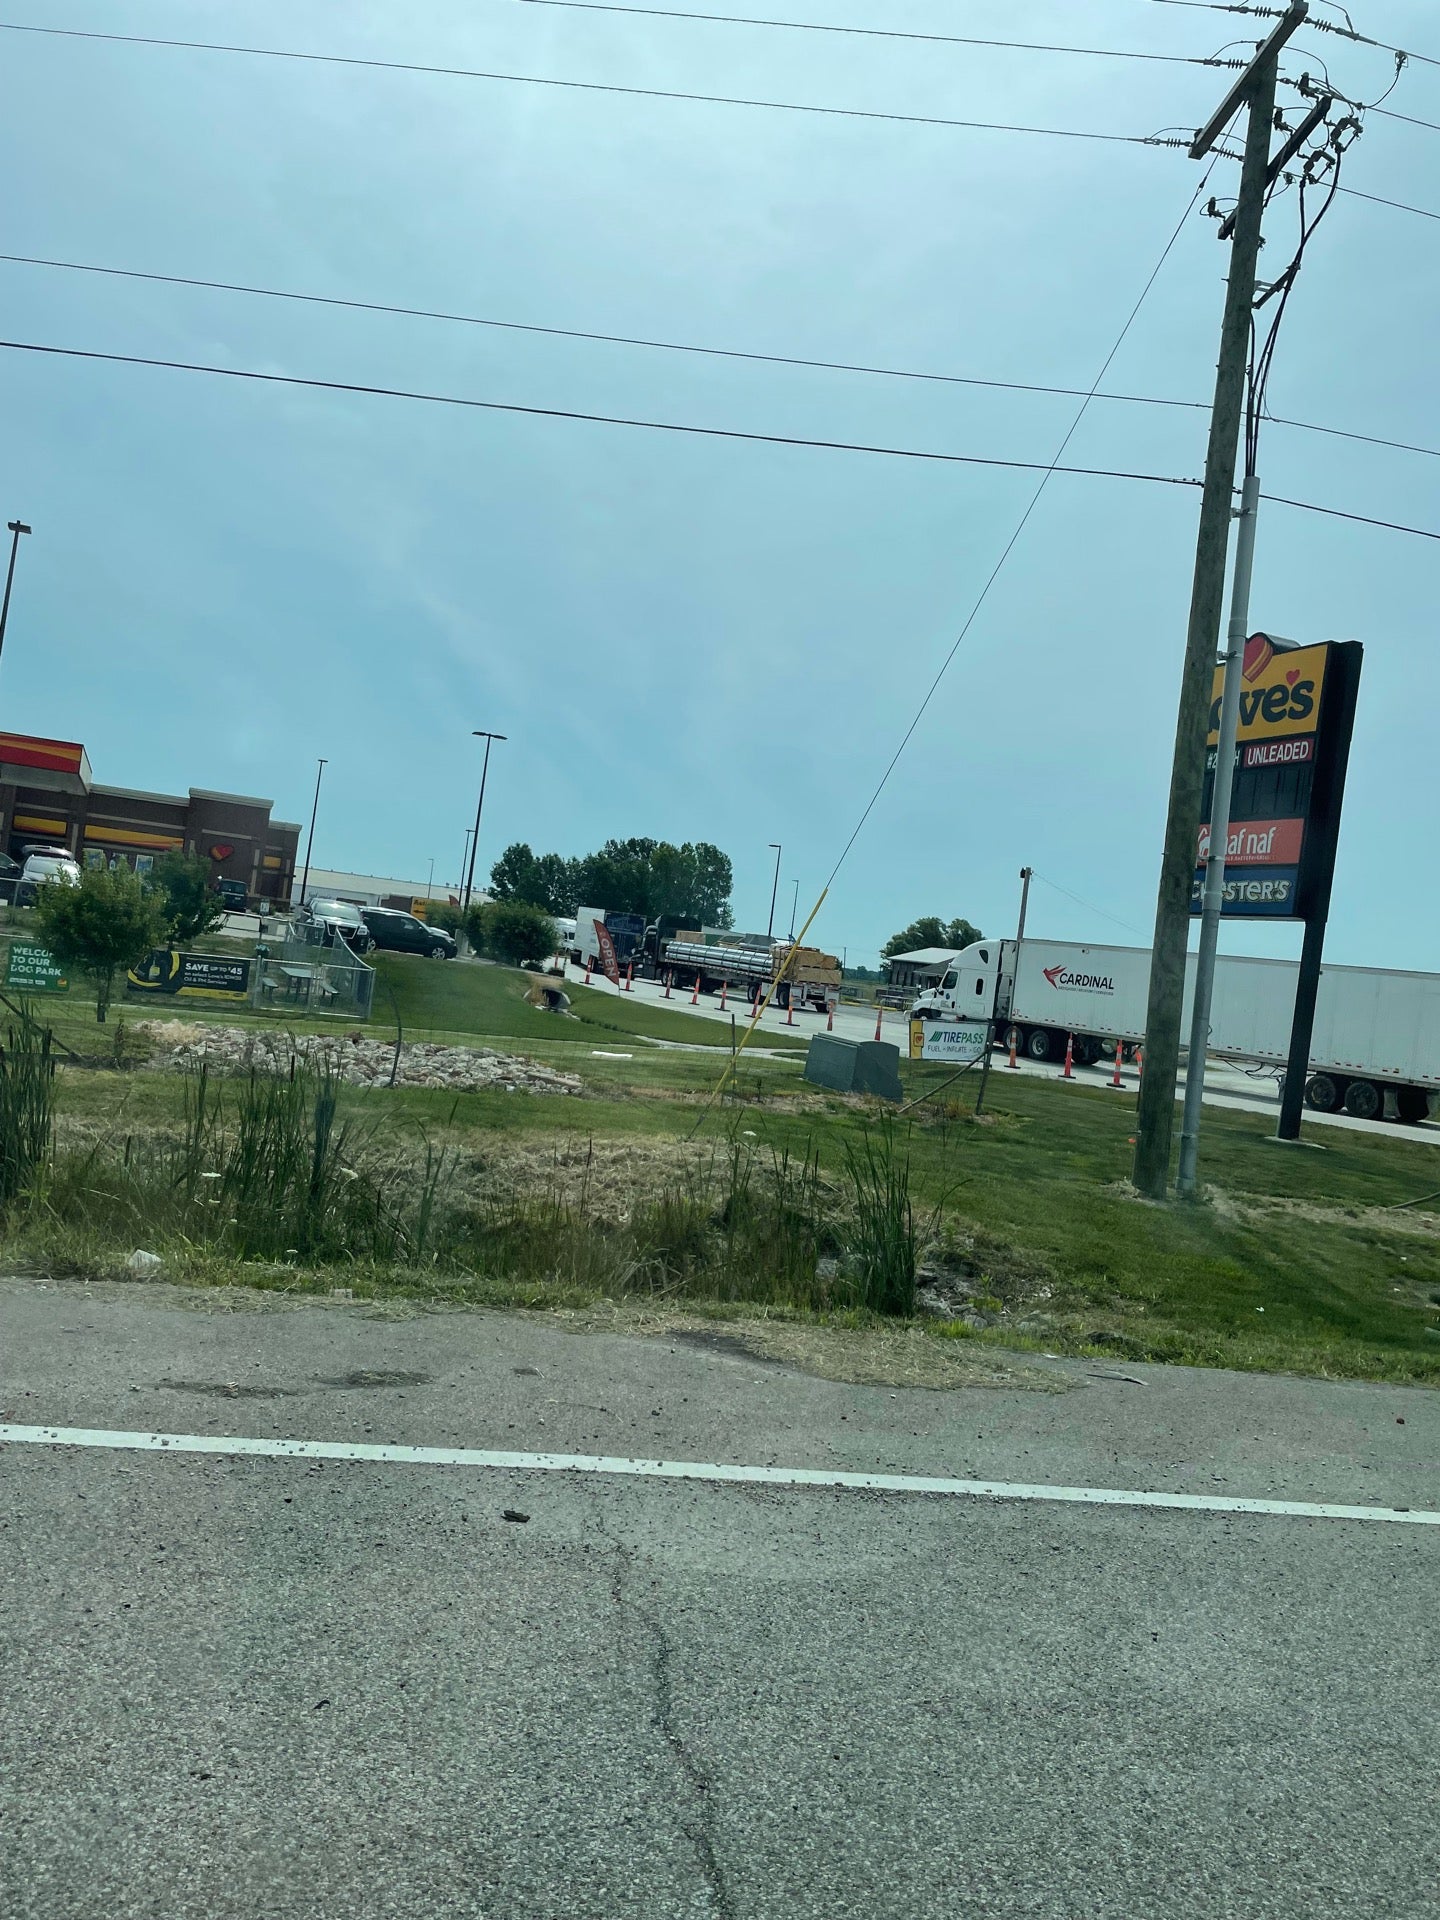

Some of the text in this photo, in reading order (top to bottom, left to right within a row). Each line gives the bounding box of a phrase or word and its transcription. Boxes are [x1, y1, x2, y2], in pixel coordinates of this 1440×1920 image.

[1247, 741, 1309, 765] UNLEADED
[1246, 827, 1277, 854] naf
[13, 946, 54, 957] WELCO
[601, 938, 616, 976] OPEN
[12, 955, 50, 966] TO OUR
[10, 964, 62, 976] DOG PARK
[186, 963, 209, 972] SAVE
[1060, 973, 1114, 989] CARDINAL
[943, 1031, 985, 1044] TIREPASS
[946, 1046, 968, 1054] INFLATE
